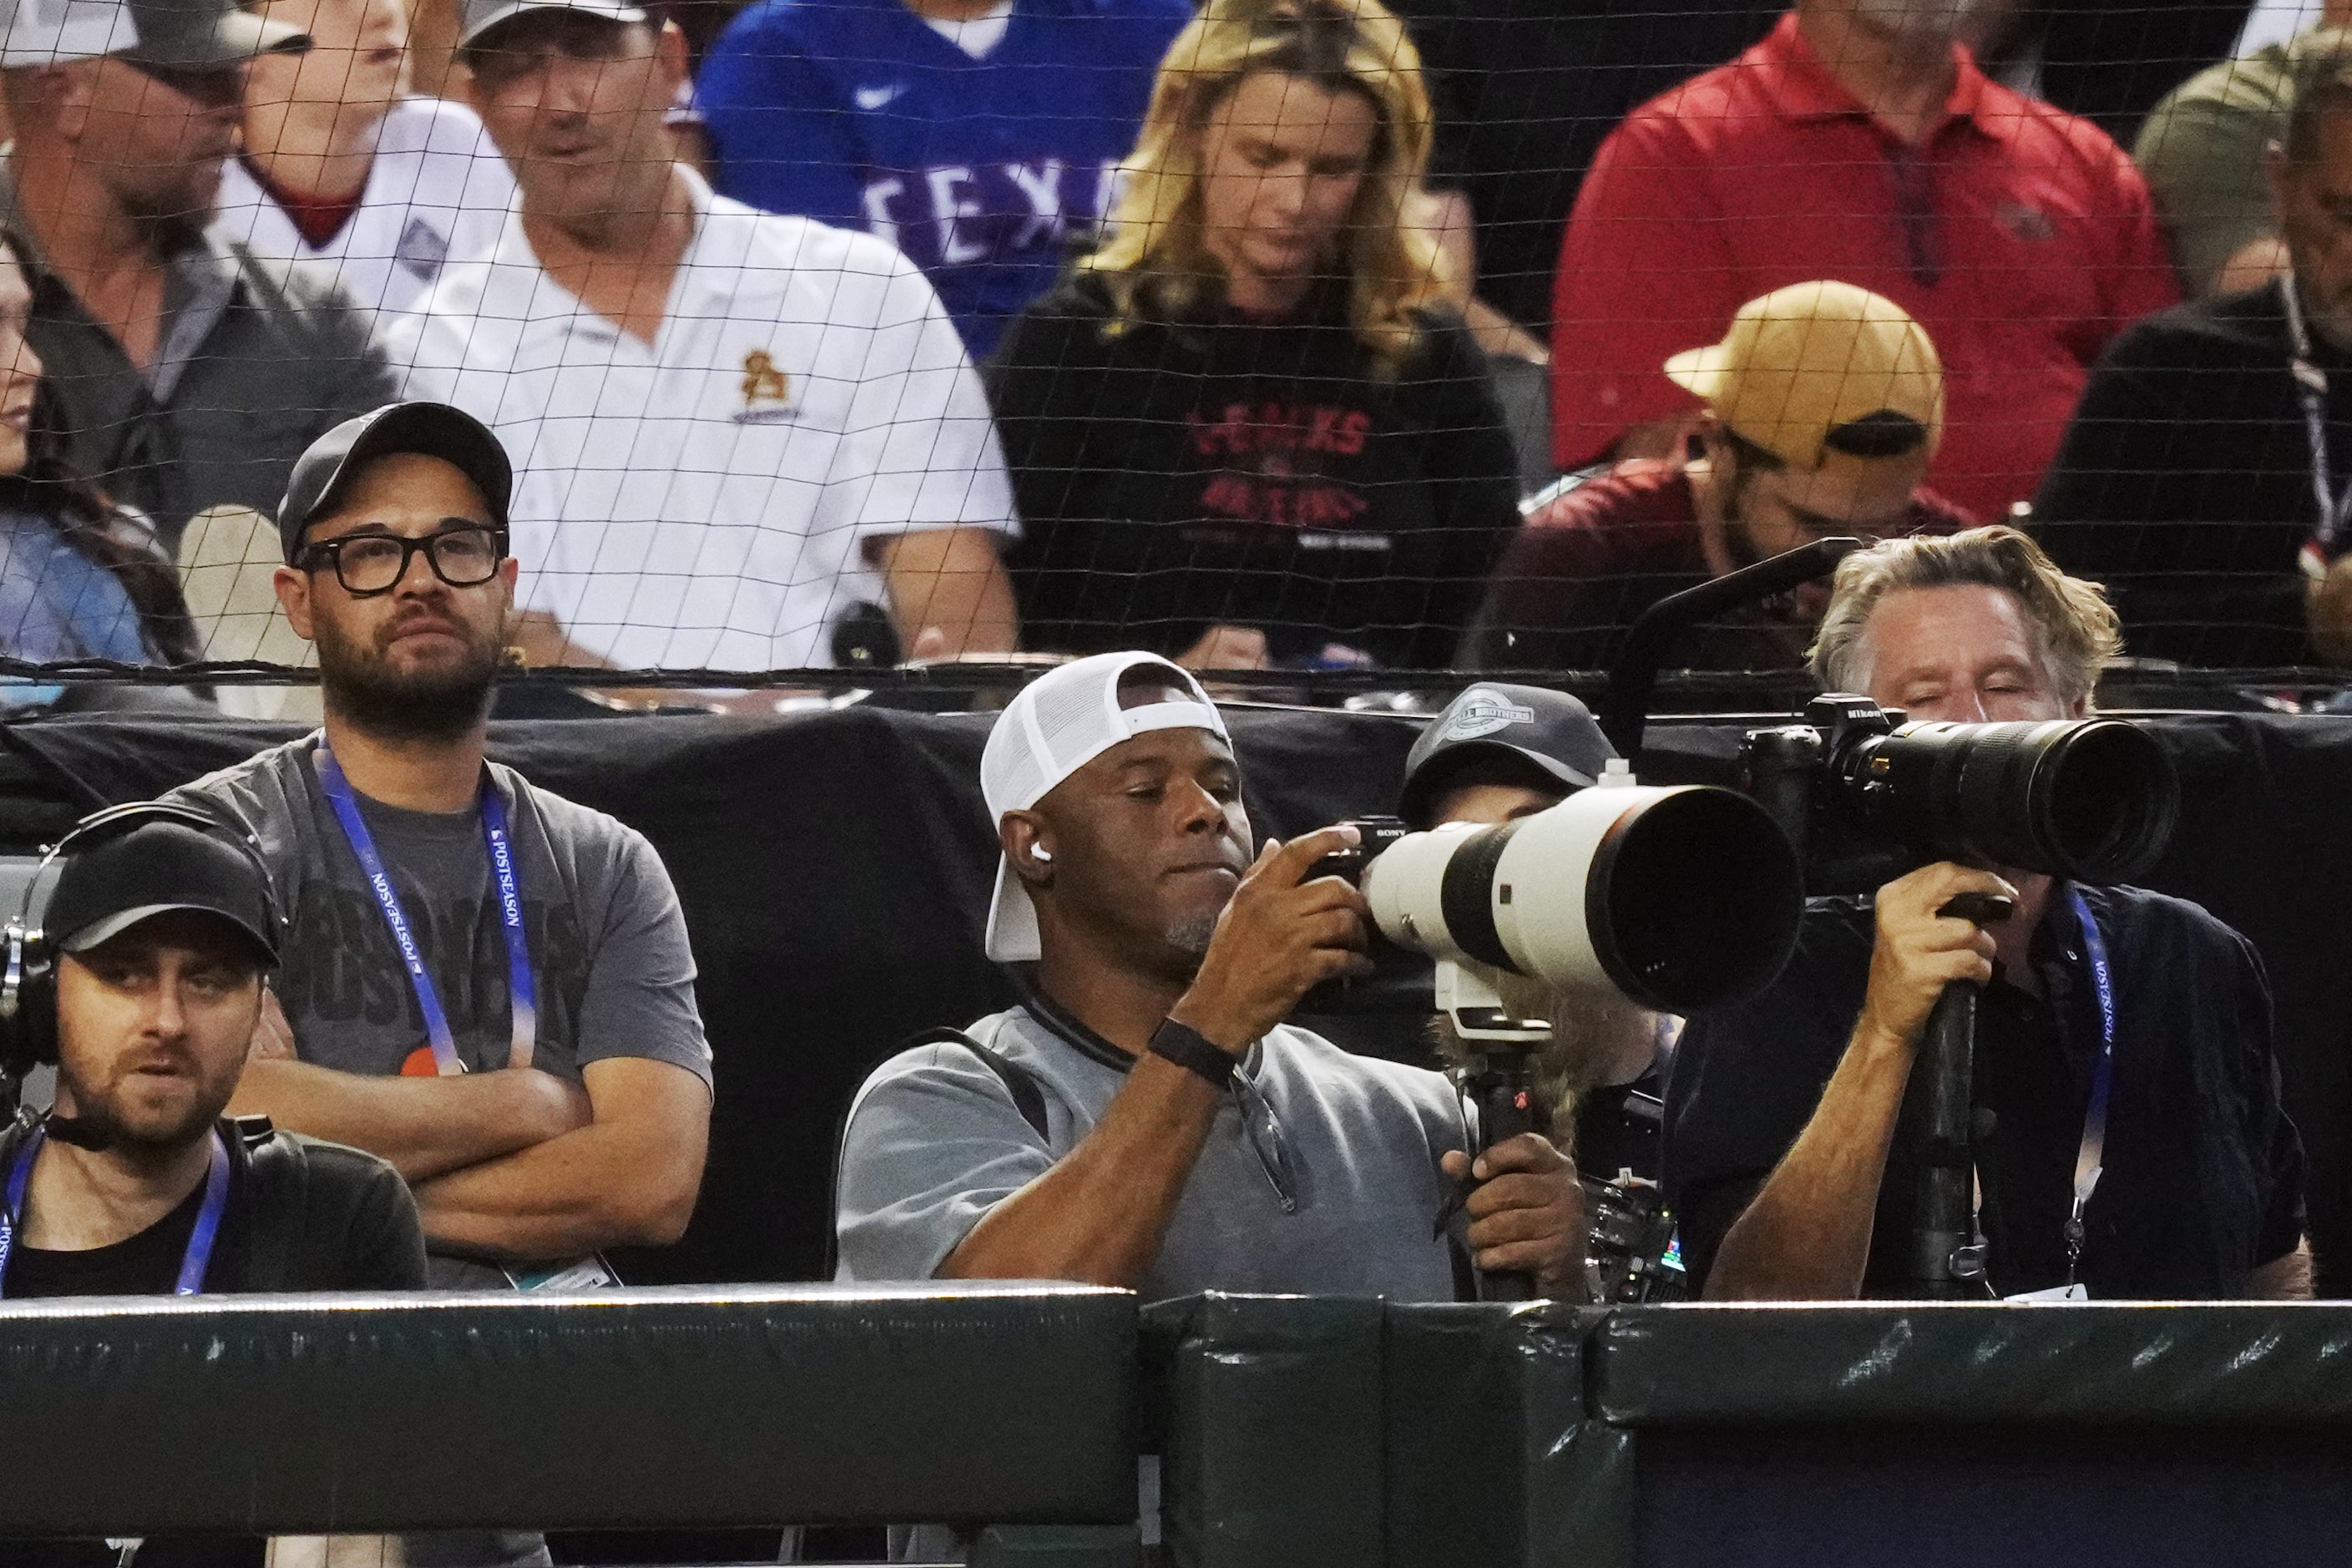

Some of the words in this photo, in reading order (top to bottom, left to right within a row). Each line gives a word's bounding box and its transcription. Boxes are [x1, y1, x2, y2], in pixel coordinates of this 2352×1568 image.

[1847, 710, 1881, 719] Nikon
[372, 873, 417, 961] POSTSEASON
[493, 841, 519, 927] POSTSEASON
[2096, 961, 2112, 1043] POSTSEASON
